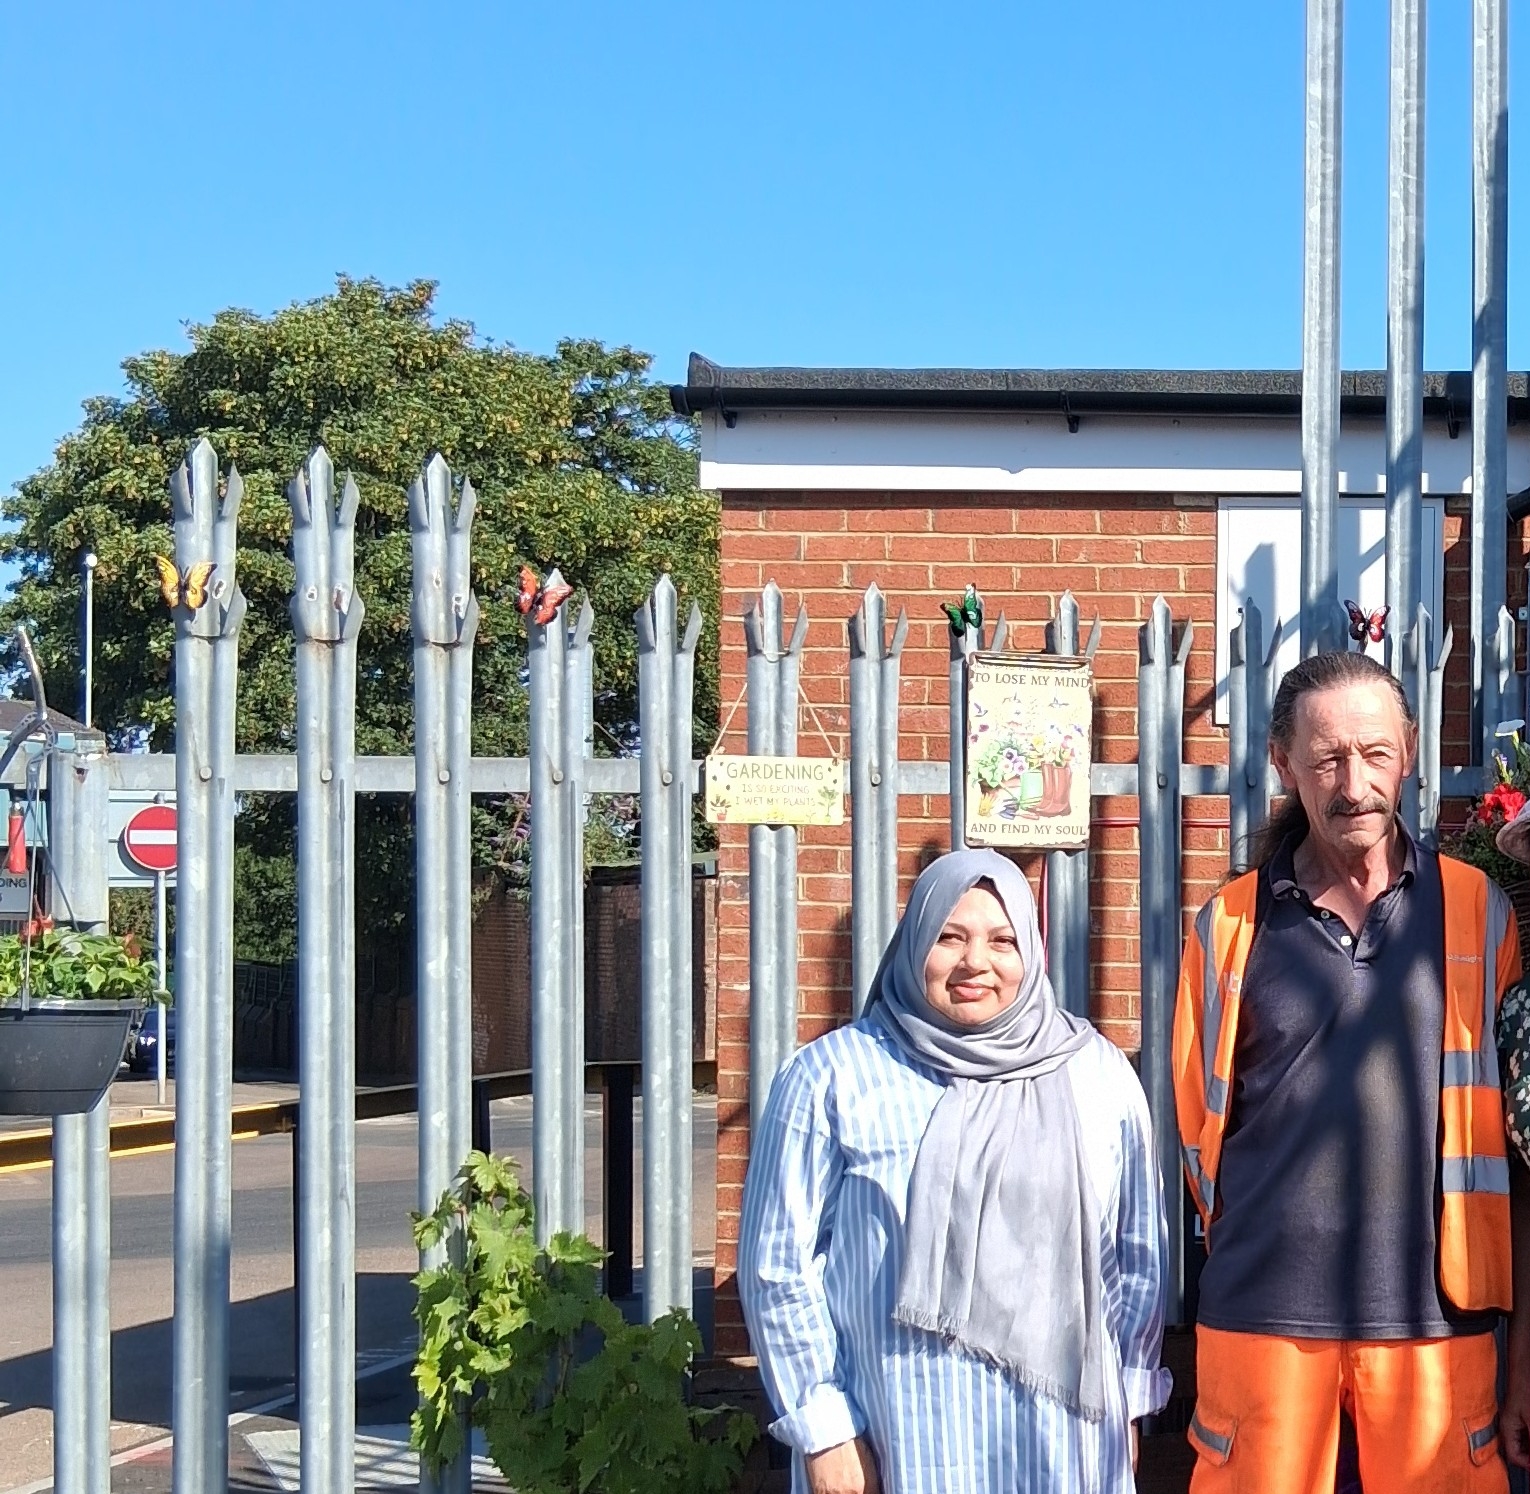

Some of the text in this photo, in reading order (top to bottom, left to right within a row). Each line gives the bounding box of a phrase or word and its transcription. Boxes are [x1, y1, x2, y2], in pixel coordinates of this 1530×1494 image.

[974, 672, 1089, 688] TO LOSE MY MIND
[726, 762, 824, 781] GARDENING
[742, 783, 810, 794] IS SO EXCITING
[735, 796, 816, 807] I WET MY PLANTS
[970, 823, 1086, 836] AND FIND MY SOUL
